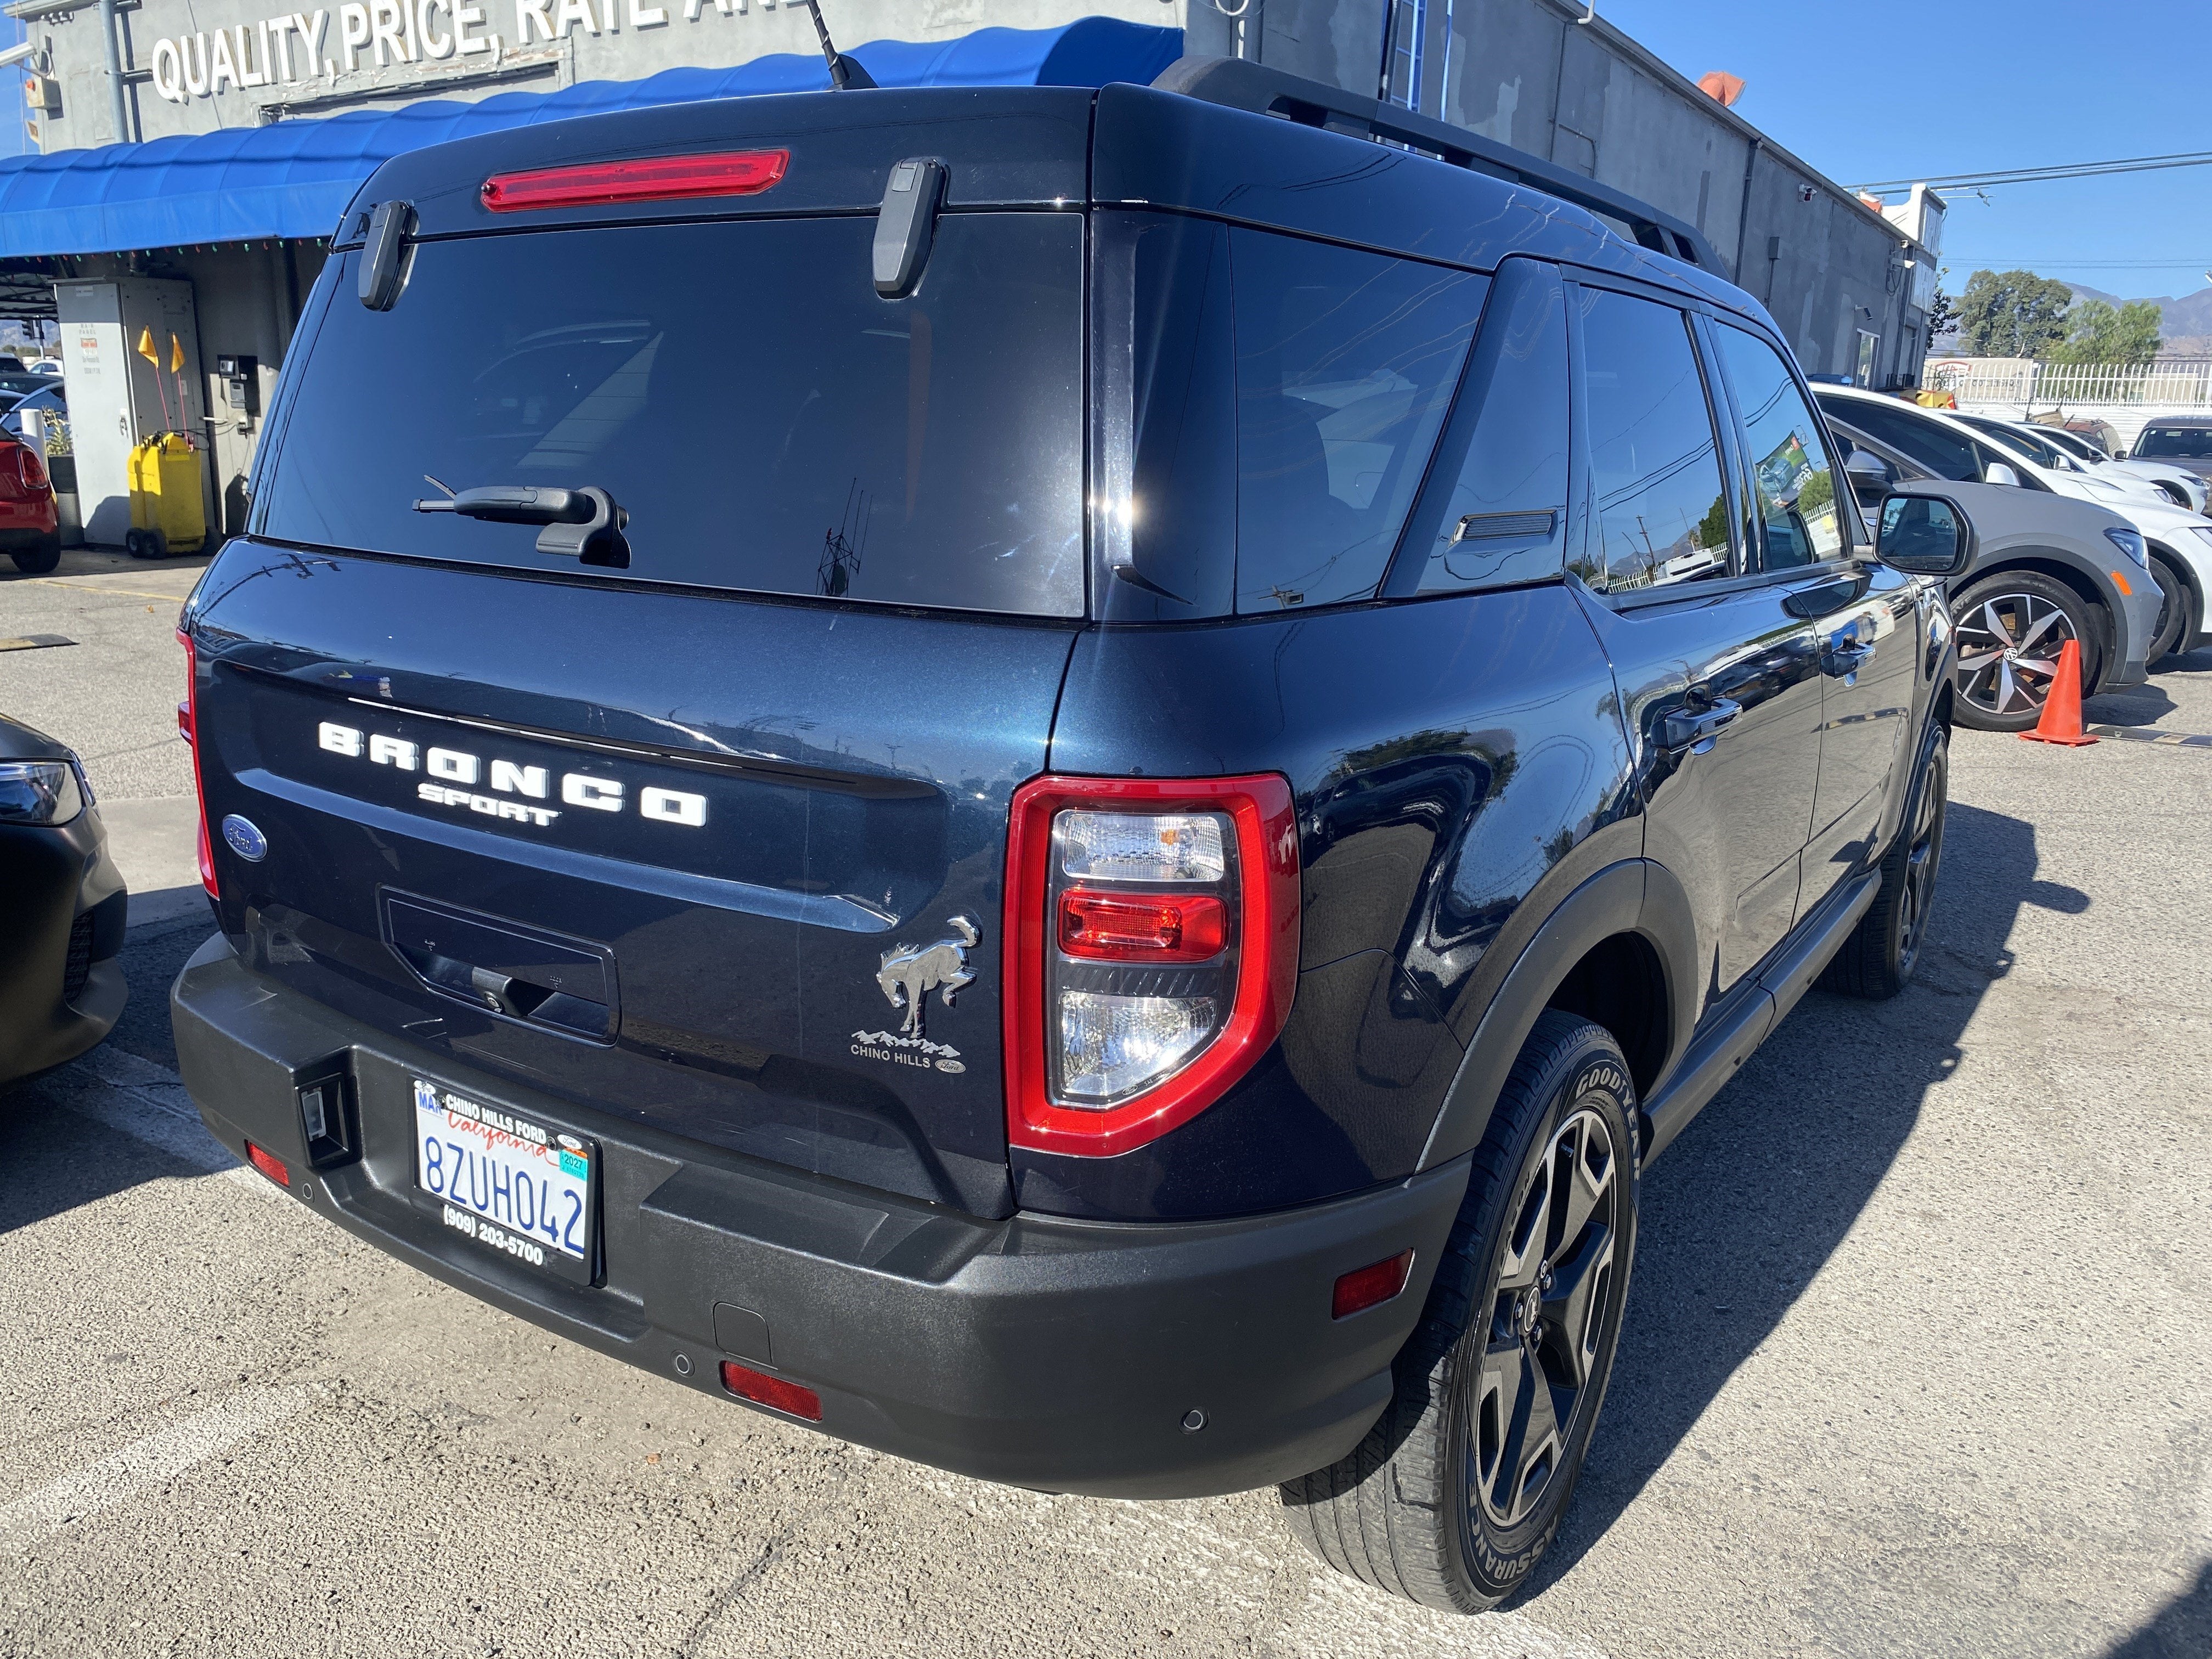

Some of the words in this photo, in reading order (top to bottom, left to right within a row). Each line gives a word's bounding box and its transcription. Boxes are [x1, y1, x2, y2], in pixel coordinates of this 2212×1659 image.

[152, 9, 336, 103] QUALITY,
[340, 0, 499, 71] PRICE,
[318, 721, 708, 827] BRONCO
[417, 783, 559, 826] SPORT
[850, 1044, 890, 1061] CHINO
[894, 1052, 930, 1068] HILLS
[446, 1093, 480, 1120] CHINO
[482, 1107, 514, 1132] HILLS
[515, 1120, 546, 1145] FORD
[448, 1111, 560, 1167] California
[1575, 1067, 1640, 1181] GOODYEAR
[565, 1154, 583, 1170] 2027
[426, 1136, 584, 1255] 8ZUH042
[444, 1204, 476, 1237] (909)
[479, 1224, 544, 1266] 203-5700
[1469, 1482, 1559, 1580] ASSURANCE
